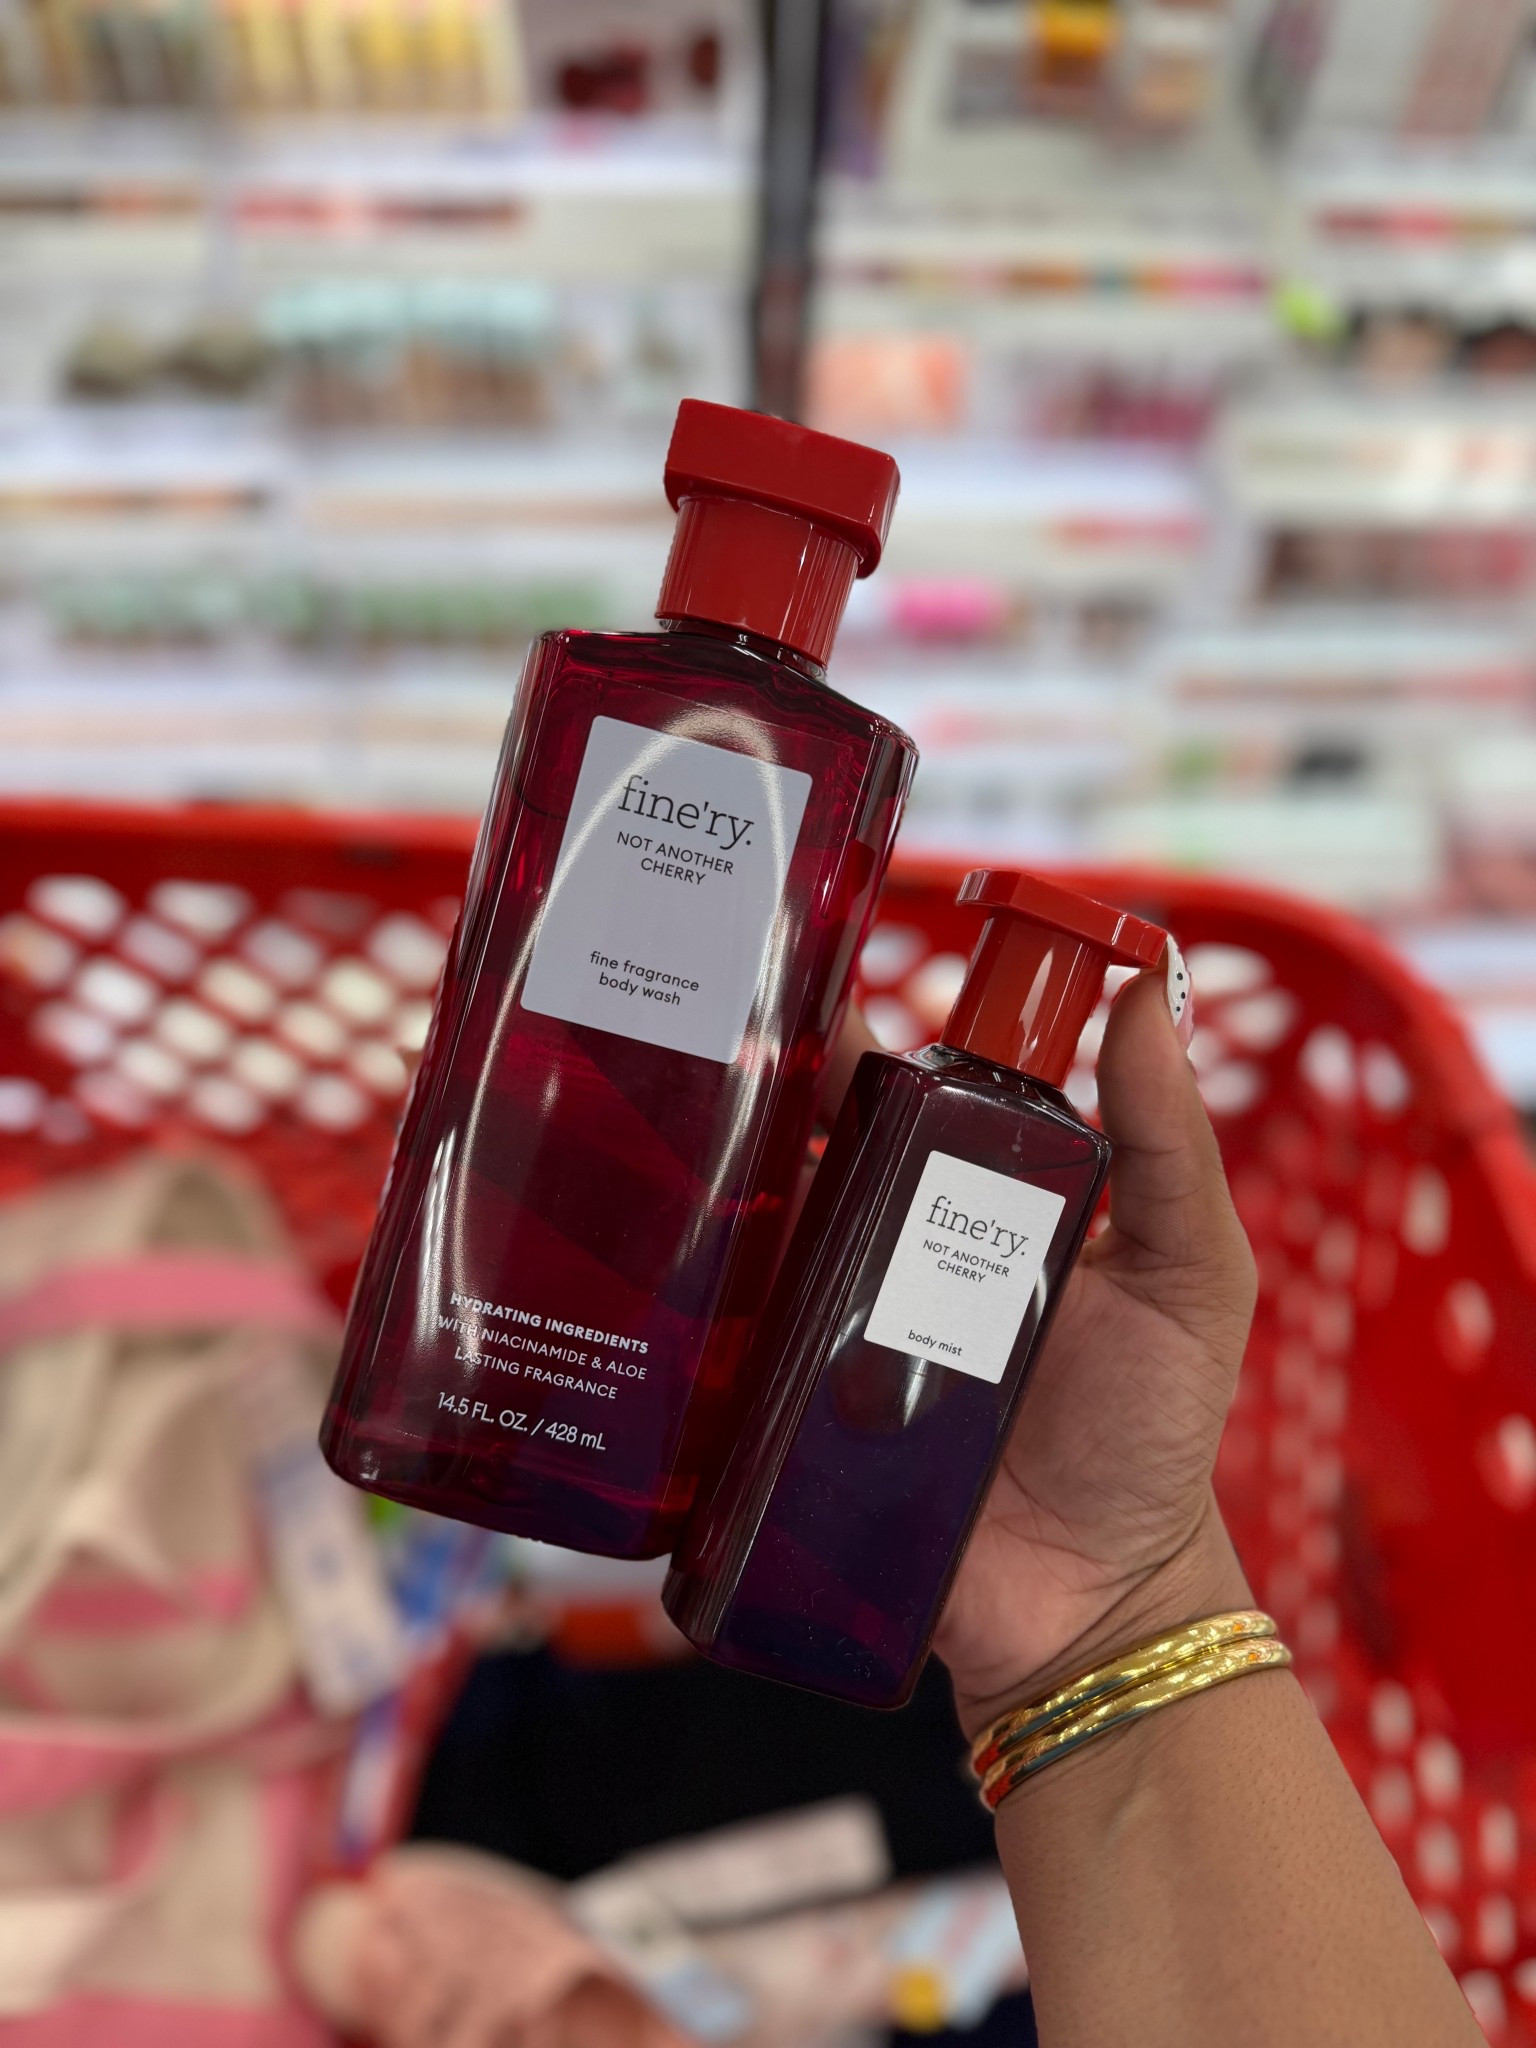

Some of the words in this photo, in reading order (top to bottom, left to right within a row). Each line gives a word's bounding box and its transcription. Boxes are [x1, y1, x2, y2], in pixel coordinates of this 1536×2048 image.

[618, 774, 755, 851] fine'ry.
[617, 832, 653, 852] NOT
[656, 843, 734, 875] ANOTHER
[640, 857, 706, 885] CHERRY
[590, 951, 618, 970] fine
[623, 960, 699, 991] fragrance
[599, 972, 639, 996] body
[643, 986, 681, 1005] wash
[926, 1195, 1028, 1258] fine'ry.
[923, 1239, 950, 1256] NOT
[951, 1250, 1010, 1277] ANOTHER
[937, 1260, 986, 1283] CHERRY
[450, 1293, 542, 1328] HYDRATING
[545, 1318, 648, 1354] INGREDIENTS
[908, 1330, 937, 1349] body
[938, 1341, 962, 1356] mist
[438, 1315, 478, 1337] WITH
[482, 1328, 588, 1365] NIACINAMIDE
[591, 1357, 602, 1370] &
[606, 1362, 648, 1380] ALOE
[454, 1346, 520, 1375] LASTING
[524, 1366, 618, 1399] FRAGRANCE
[437, 1391, 469, 1415] 14.5
[471, 1403, 495, 1423] FL.
[499, 1410, 528, 1432] OZ.
[530, 1418, 545, 1436] /
[545, 1422, 577, 1444] 428
[580, 1432, 606, 1450] mL
